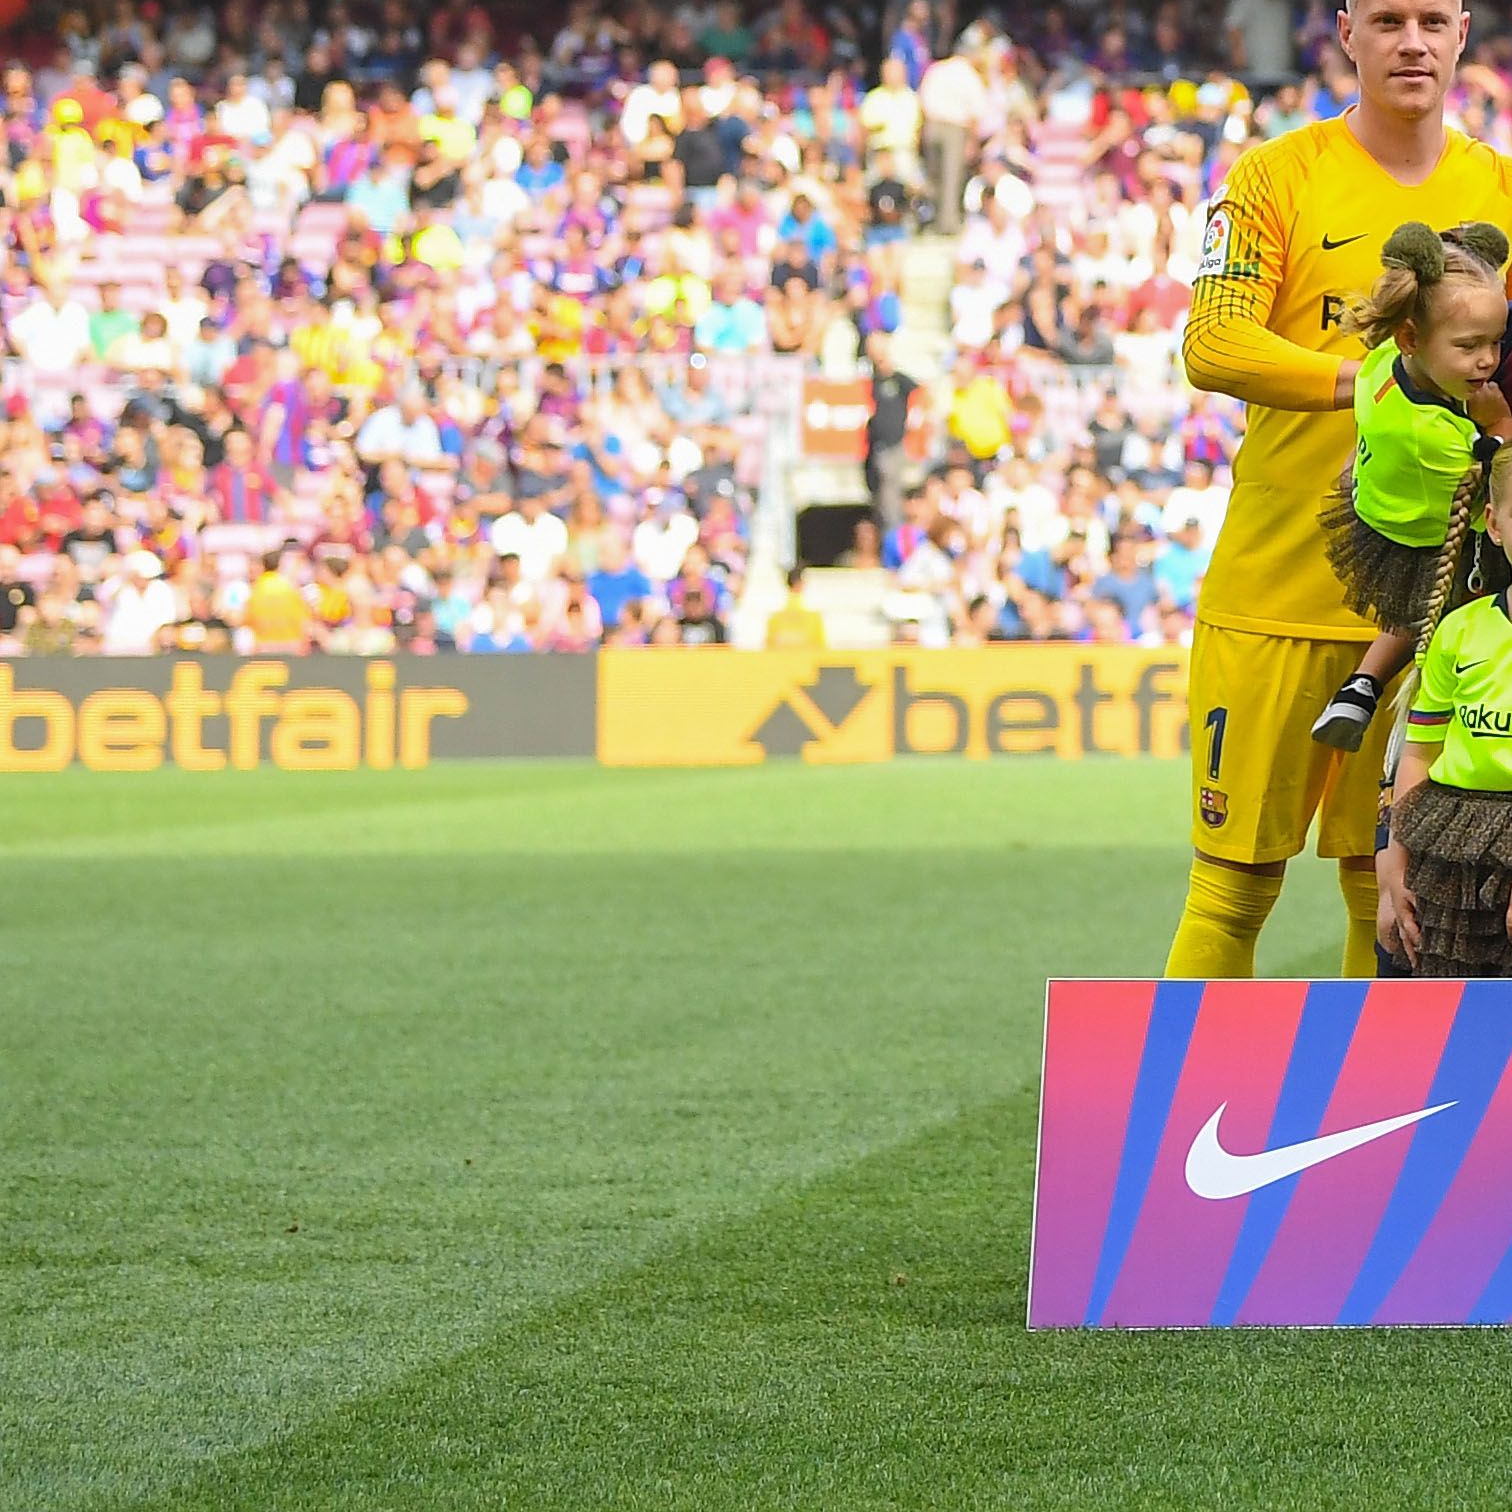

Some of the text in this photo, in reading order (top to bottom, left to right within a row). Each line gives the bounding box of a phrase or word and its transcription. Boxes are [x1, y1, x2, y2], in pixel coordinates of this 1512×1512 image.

[0, 660, 469, 771] betfair
[894, 664, 1190, 753] betf
[1204, 707, 1228, 782] 1
